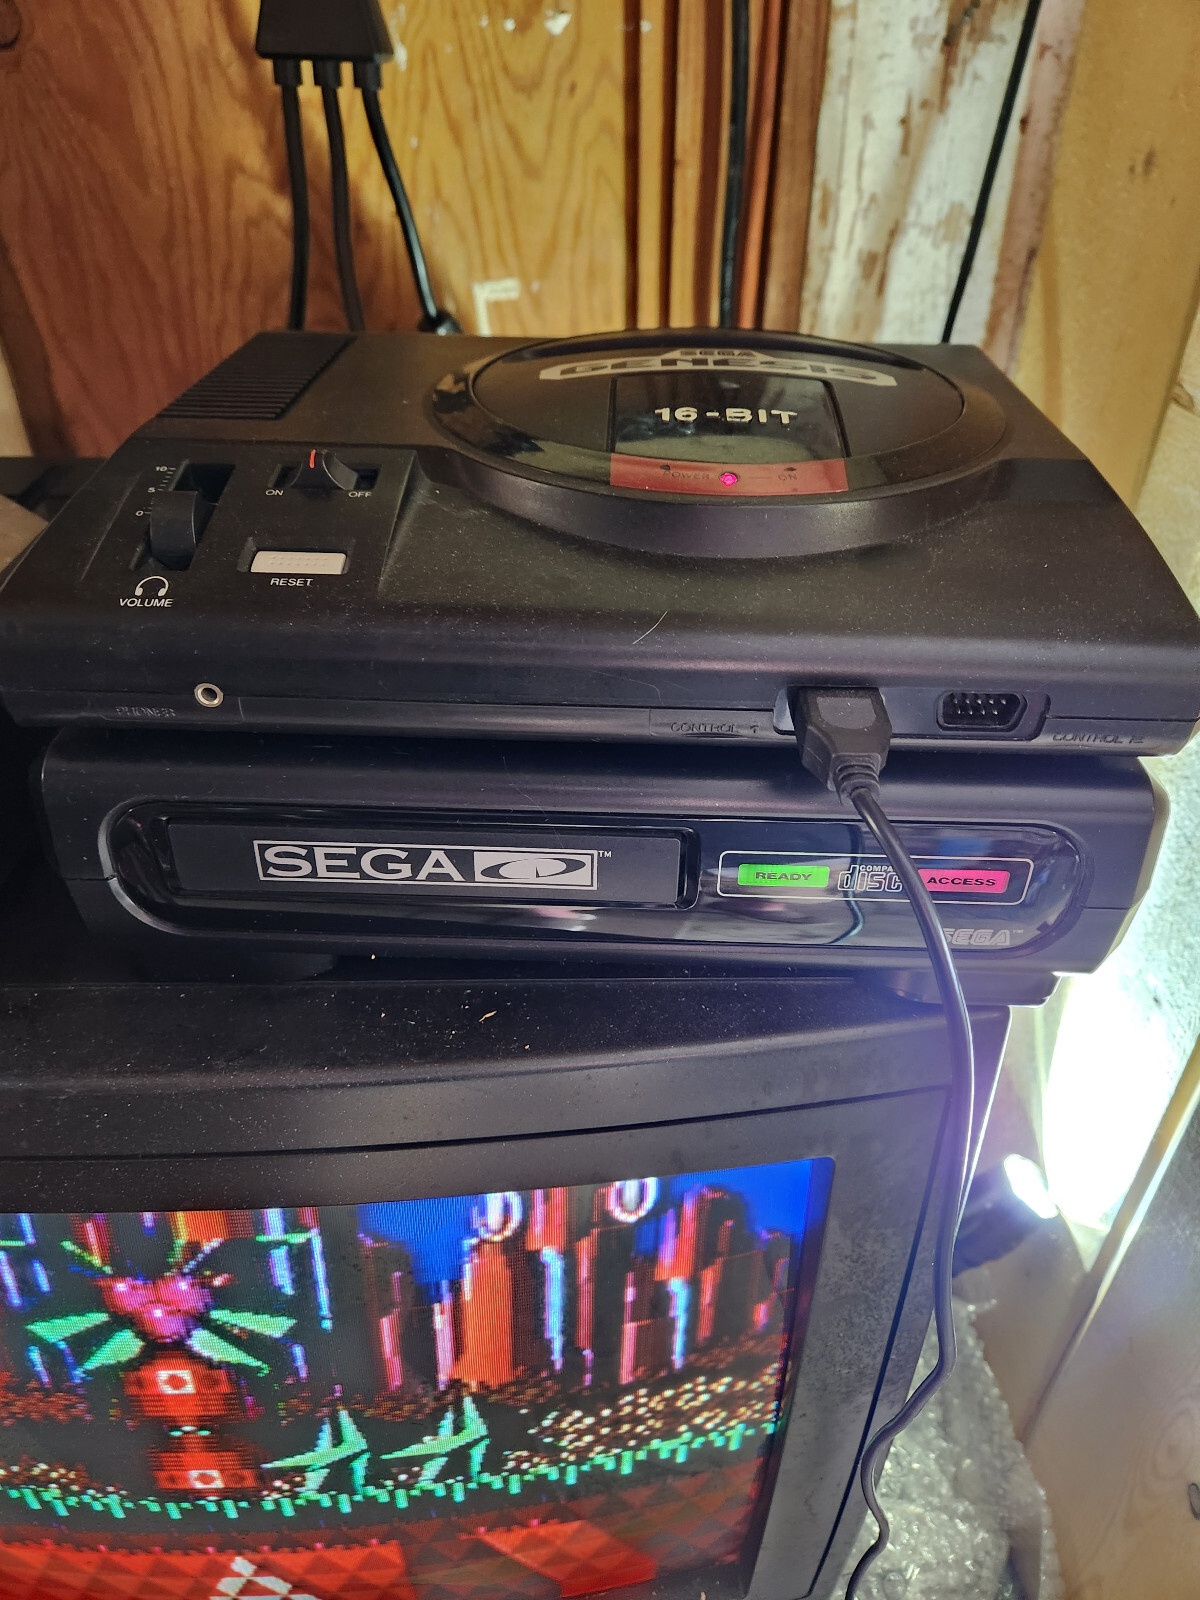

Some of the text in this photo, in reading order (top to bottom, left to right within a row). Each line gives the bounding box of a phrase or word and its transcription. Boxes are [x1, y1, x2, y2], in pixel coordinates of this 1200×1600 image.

[560, 357, 877, 381] GENESIS
[663, 470, 710, 480] POWER
[270, 577, 313, 587] RESET
[119, 597, 173, 607] VOLUME
[670, 722, 739, 733] CONTROL
[1052, 733, 1123, 744] CONTROL
[263, 845, 466, 882] SEGA
[755, 870, 812, 882] READY
[926, 876, 996, 887] ACCESS
